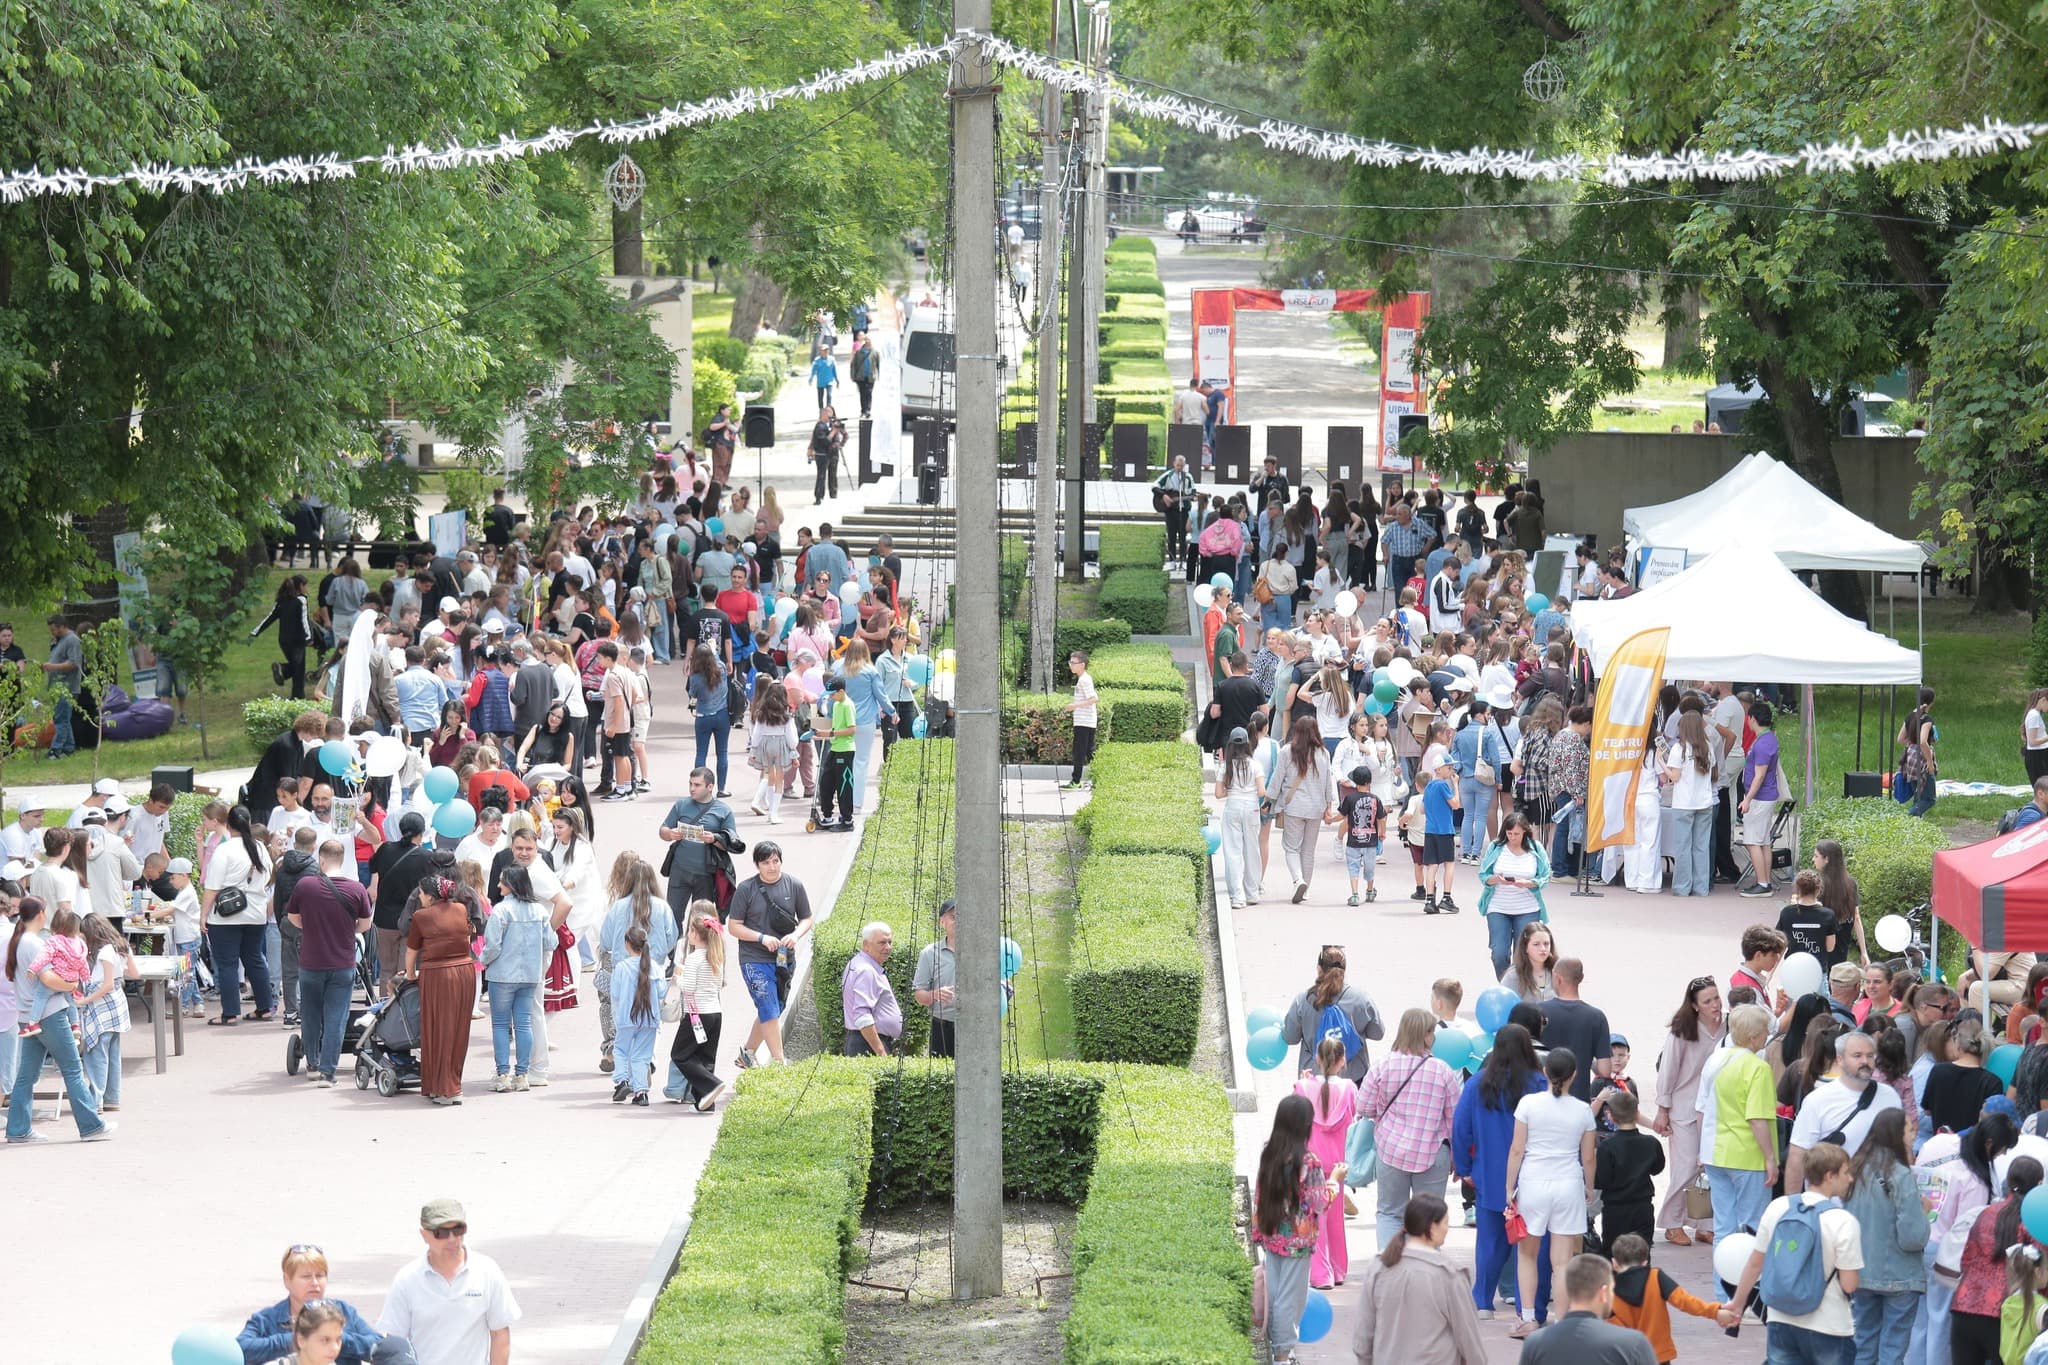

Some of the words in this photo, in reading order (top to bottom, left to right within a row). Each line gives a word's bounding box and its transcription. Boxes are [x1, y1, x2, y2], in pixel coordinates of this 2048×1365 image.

[1208, 327, 1227, 335] UIPM
[1388, 405, 1410, 414] UIPM
[1595, 750, 1610, 760] DE
